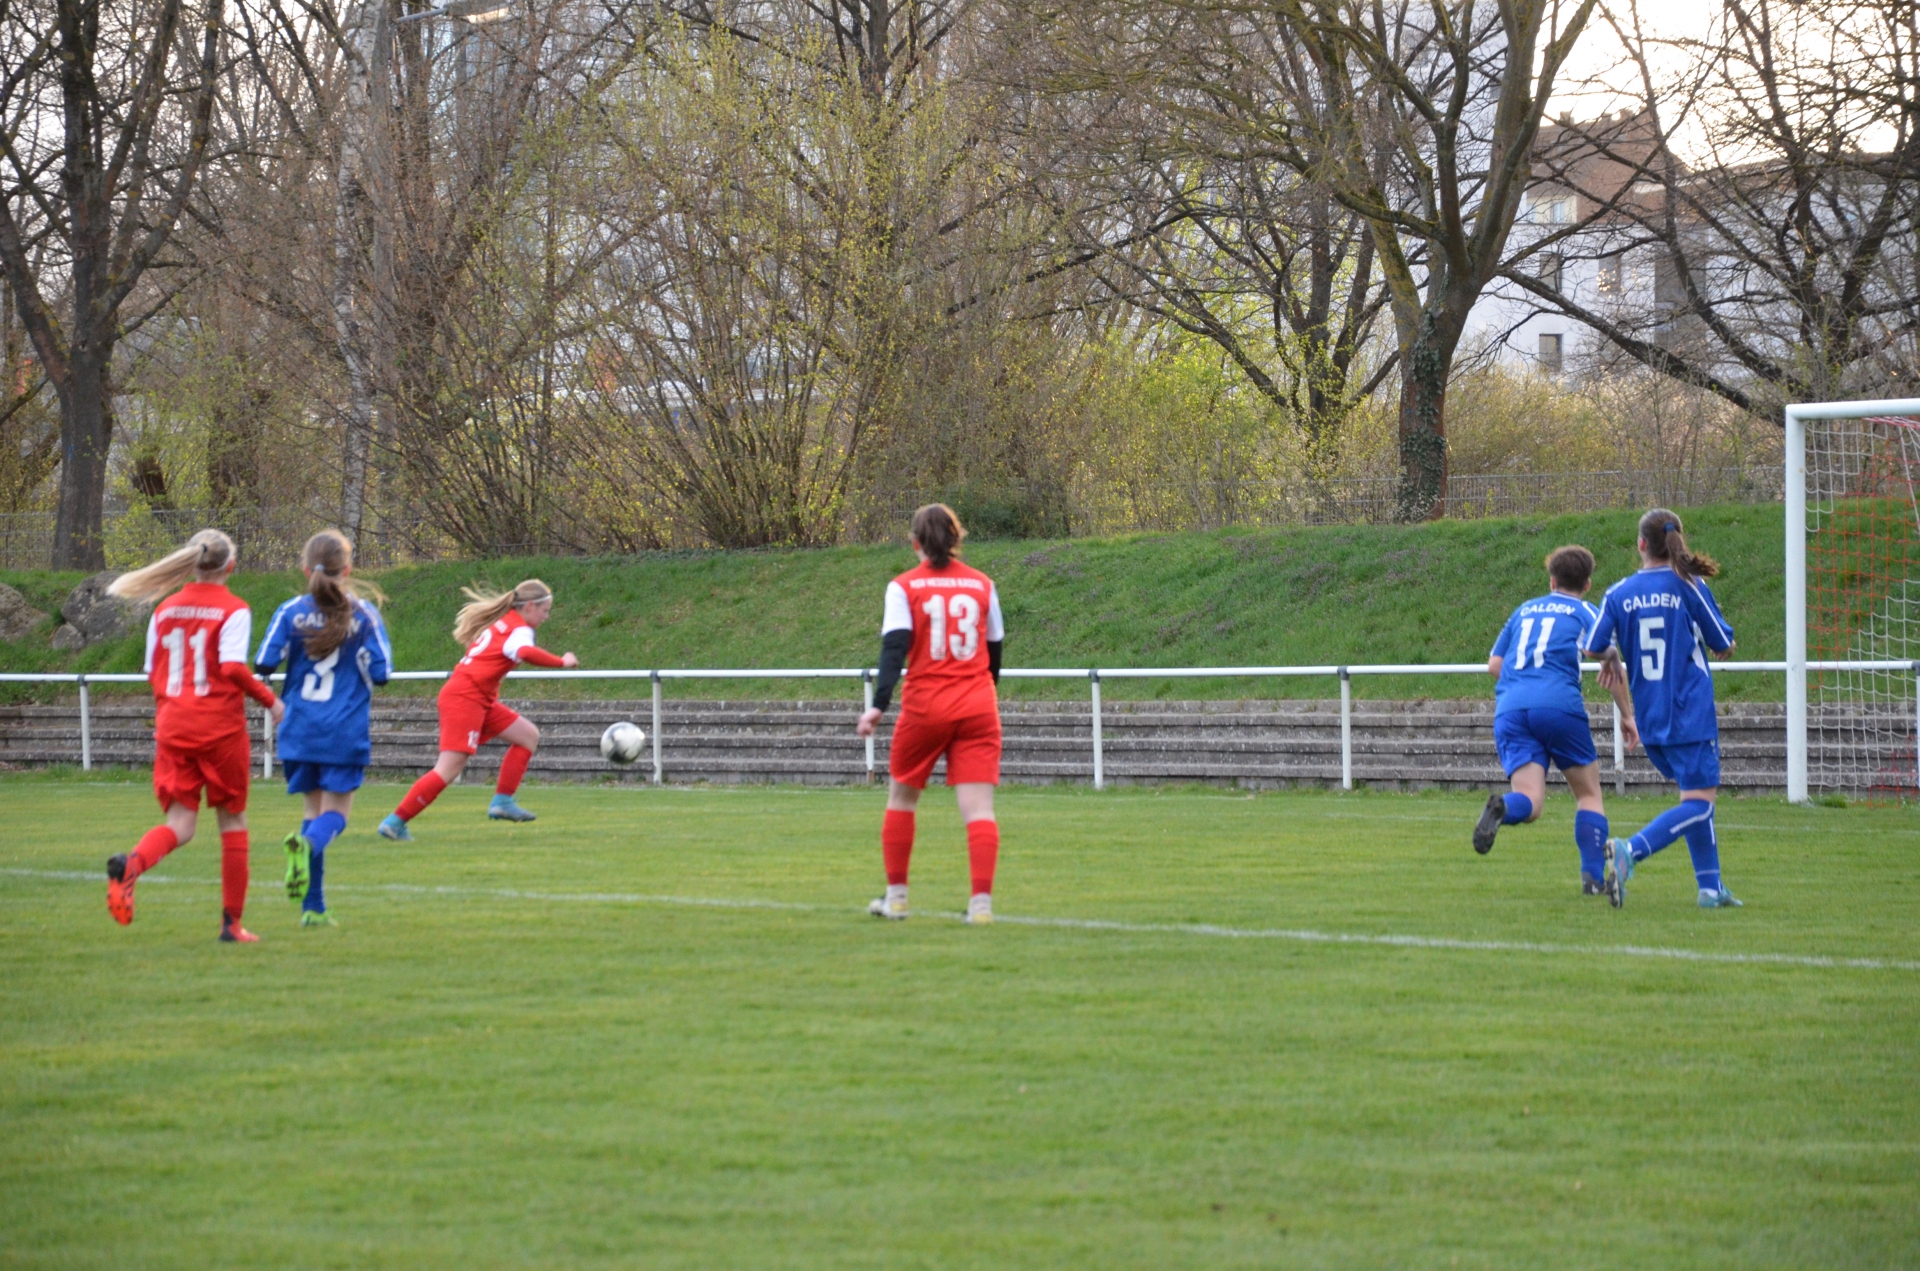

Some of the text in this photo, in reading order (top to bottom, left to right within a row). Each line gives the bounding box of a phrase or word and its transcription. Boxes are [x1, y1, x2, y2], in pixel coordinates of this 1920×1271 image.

[926, 577, 957, 589] HESSEN
[1623, 593, 1681, 613] CALDEN
[293, 612, 361, 639] CALN
[922, 594, 980, 662] 13
[1520, 602, 1576, 617] CALDEN
[161, 627, 211, 698] 11
[1514, 617, 1556, 670] 11
[1639, 616, 1666, 681] 5
